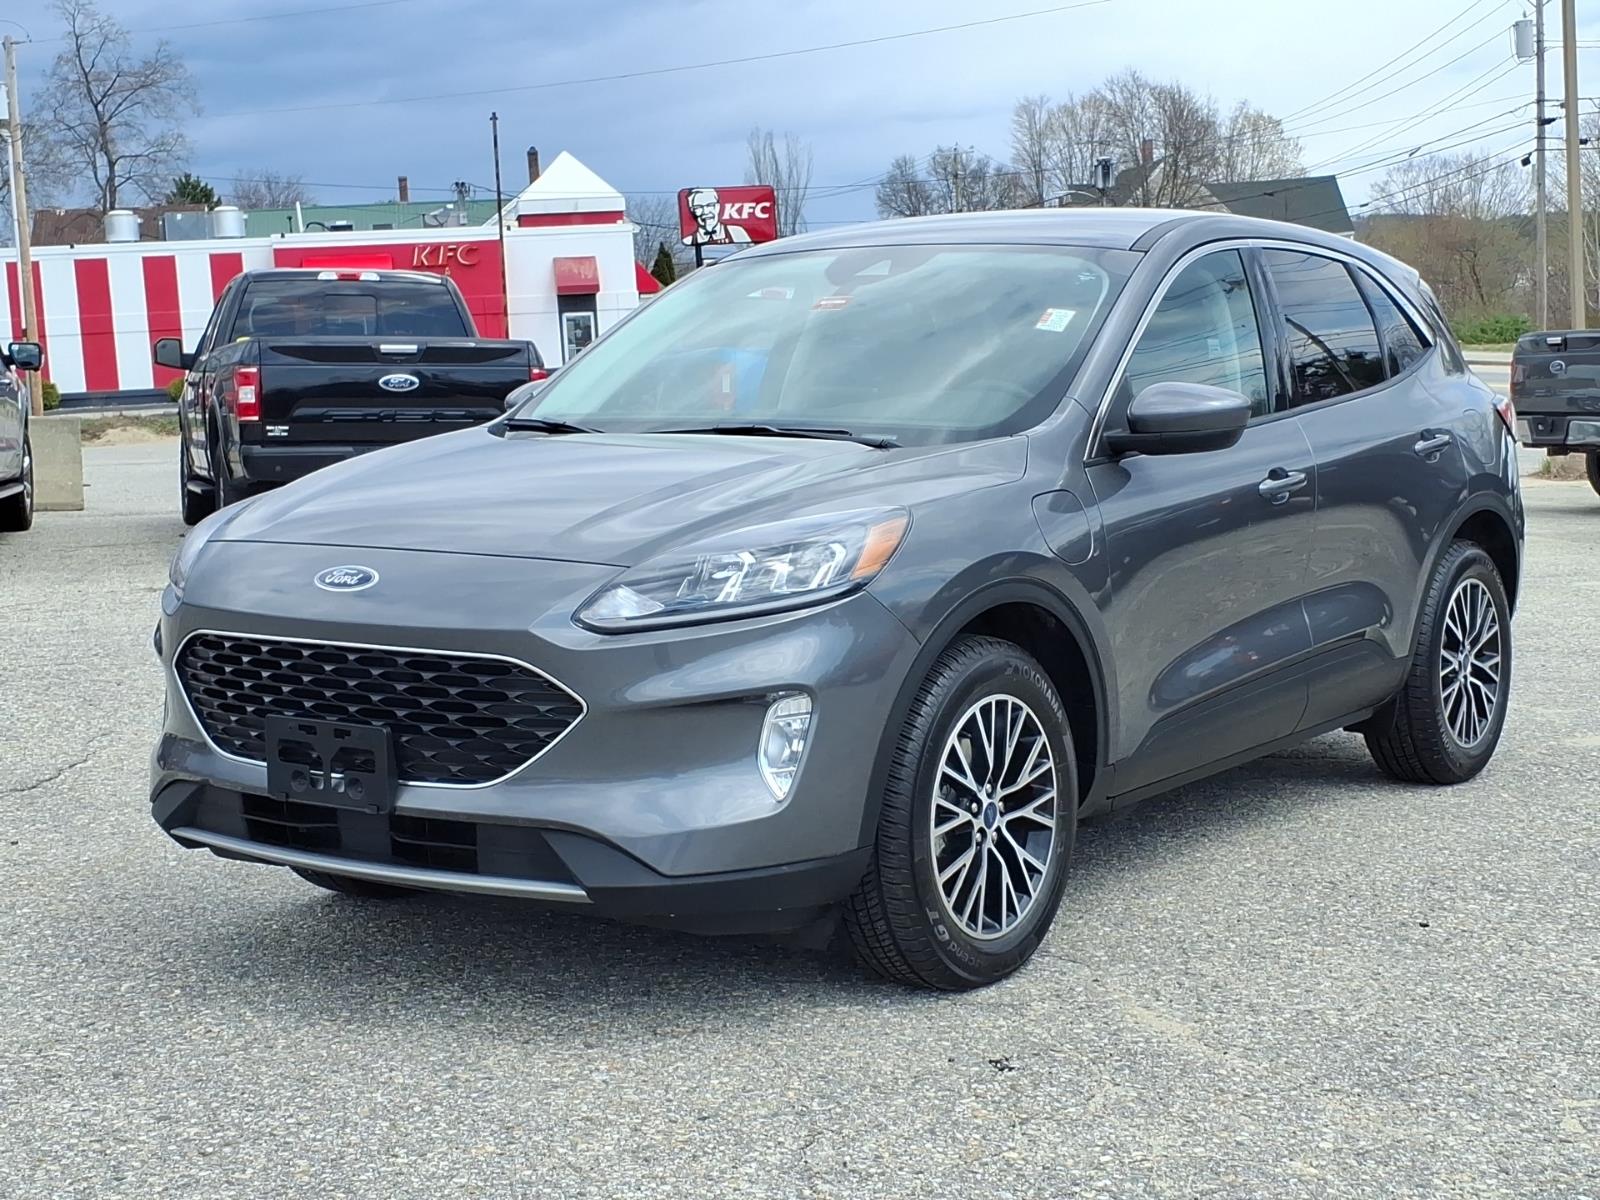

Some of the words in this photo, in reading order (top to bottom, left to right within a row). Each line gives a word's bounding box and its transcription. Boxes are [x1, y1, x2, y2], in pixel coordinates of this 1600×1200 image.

[722, 202, 771, 220] KFC
[412, 243, 480, 266] KFC
[325, 568, 364, 585] Ford
[1017, 664, 1062, 723] YOKOHAMA
[926, 907, 950, 942] GT
